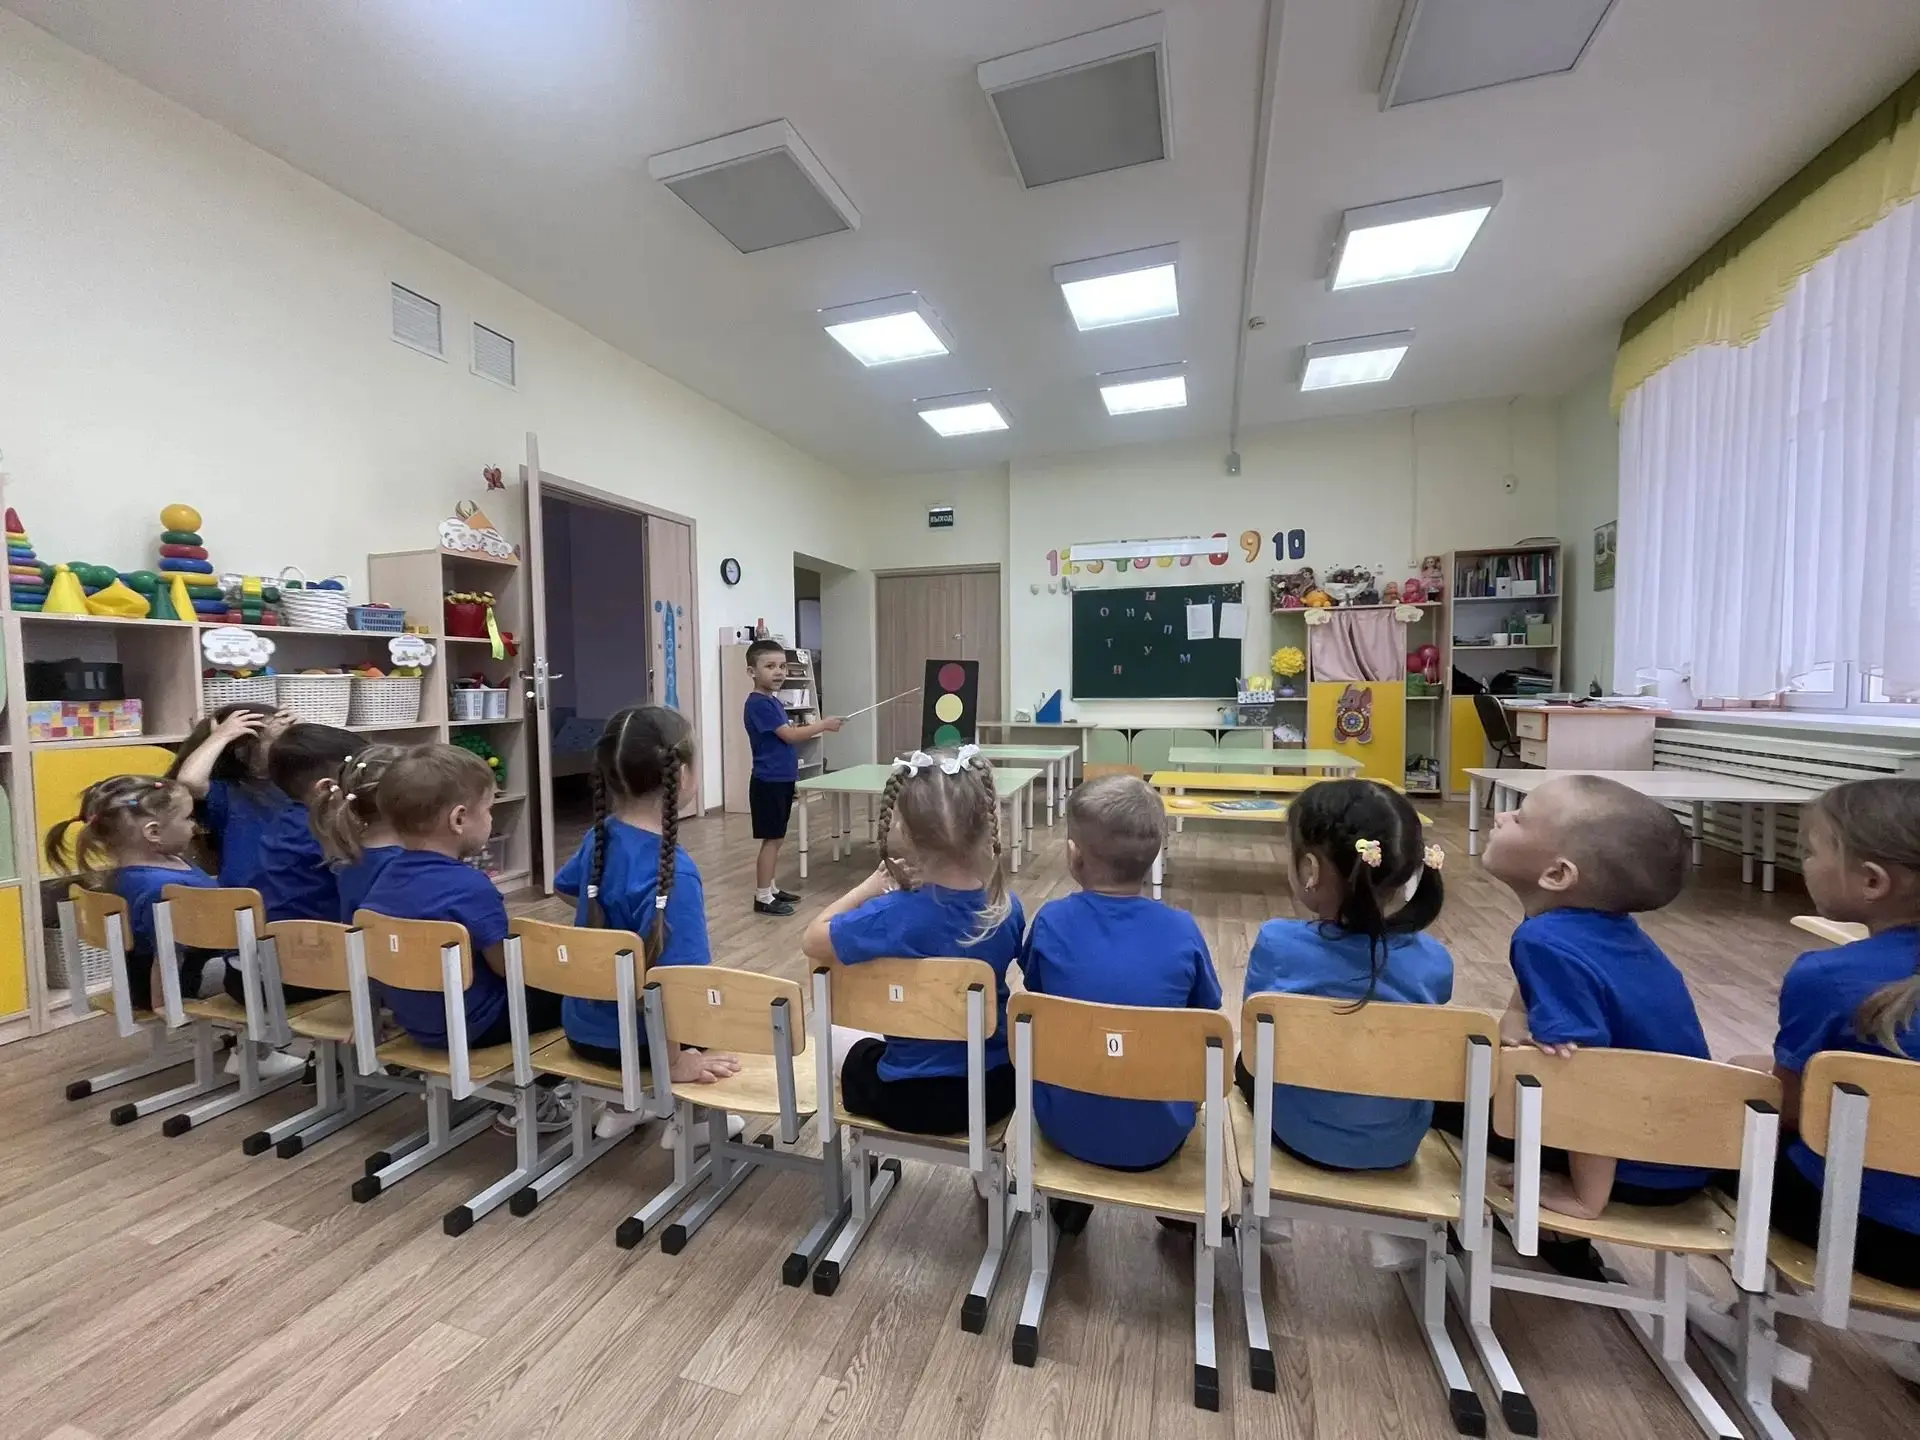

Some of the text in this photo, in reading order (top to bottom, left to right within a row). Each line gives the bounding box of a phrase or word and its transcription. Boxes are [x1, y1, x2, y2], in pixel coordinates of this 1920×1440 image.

[1046, 549, 1058, 576] 1
[1240, 530, 1261, 563] 9
[1272, 529, 1305, 561] 10
[1144, 611, 1153, 621] А
[1180, 653, 1191, 664] М
[1109, 1038, 1119, 1053] 0
